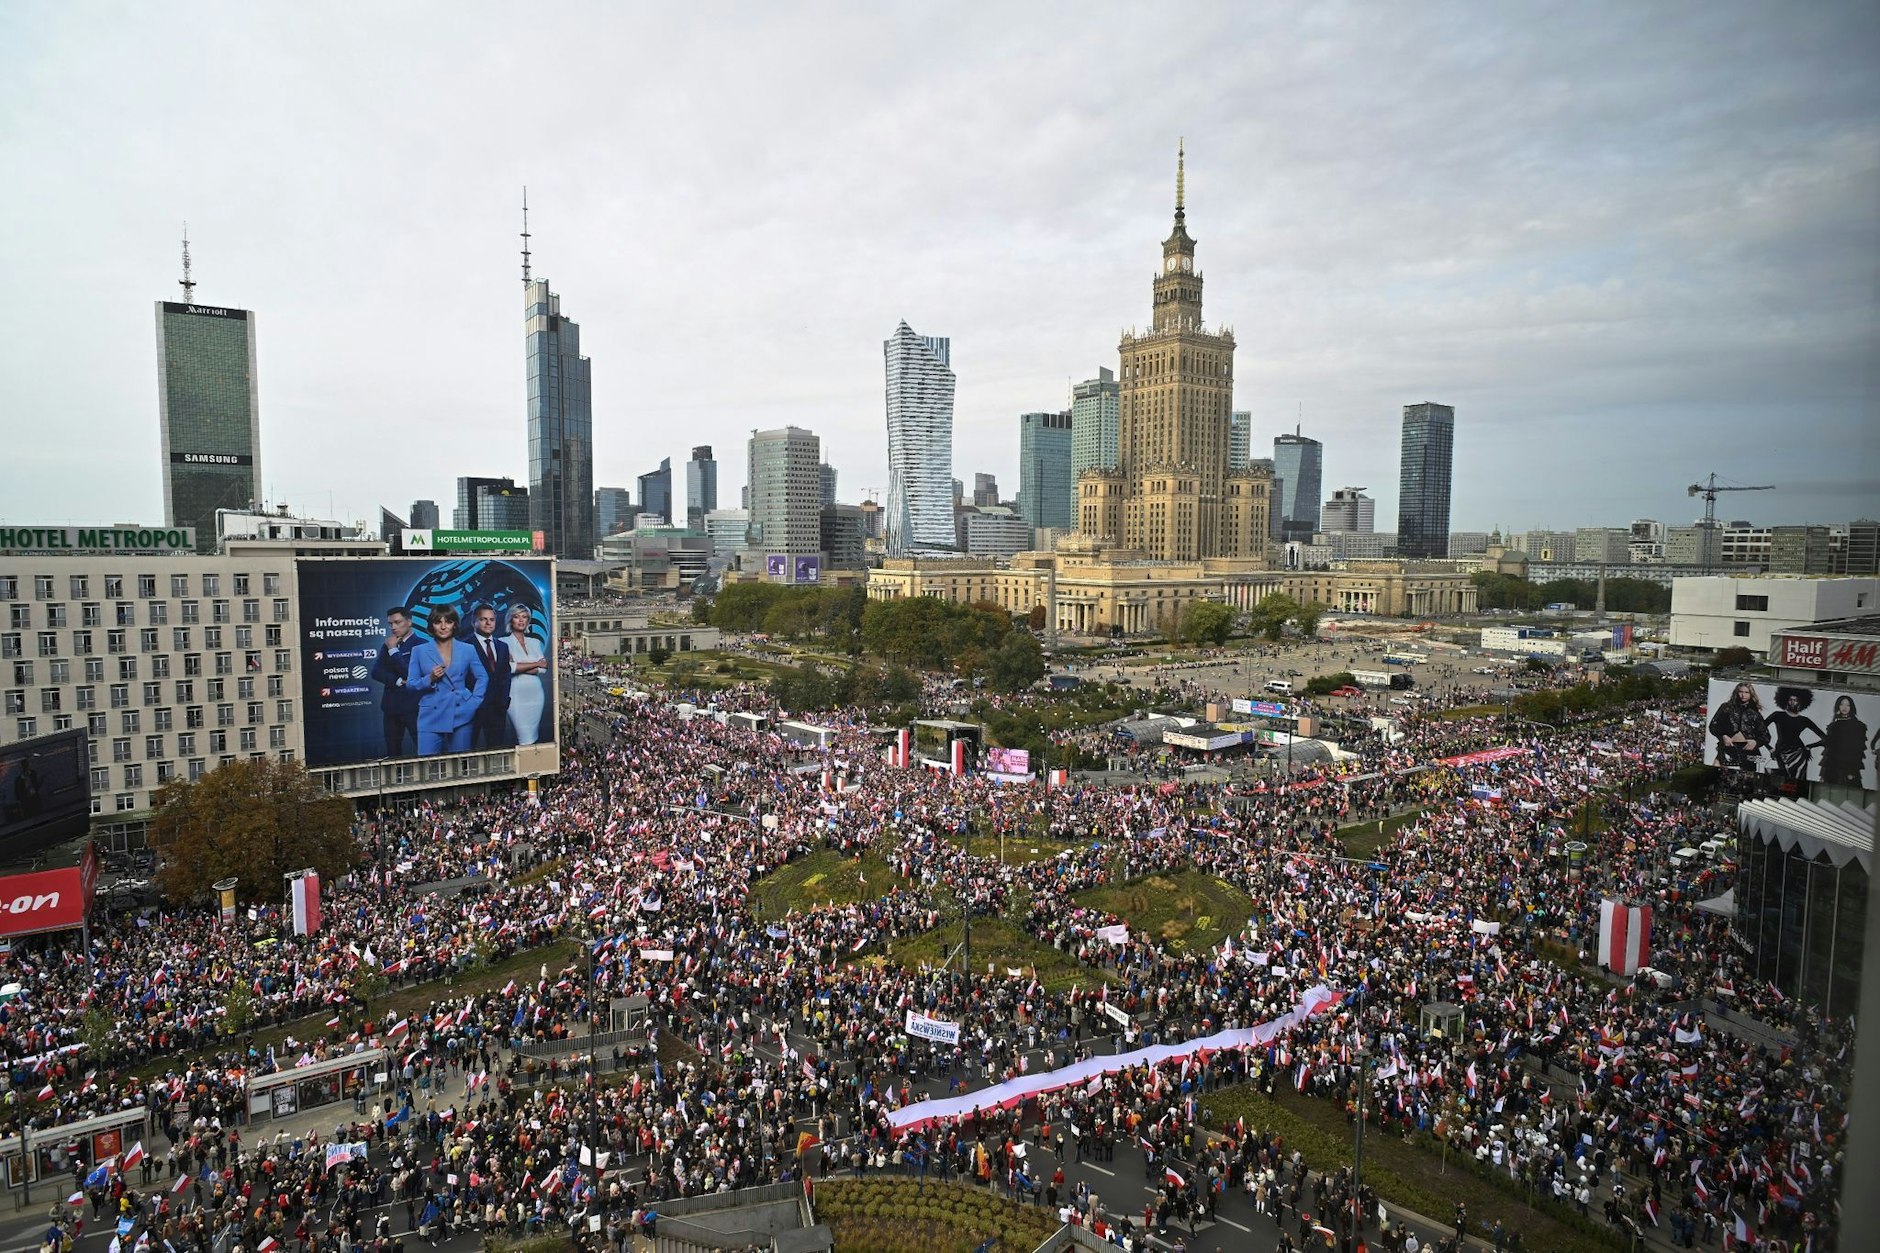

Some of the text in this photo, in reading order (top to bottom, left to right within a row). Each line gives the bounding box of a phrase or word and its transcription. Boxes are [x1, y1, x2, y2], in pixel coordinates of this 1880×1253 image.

[186, 305, 227, 316] Marriott
[184, 453, 238, 464] SAMSUNG
[0, 528, 192, 549] HOTEL METROPOL
[437, 536, 530, 544] HOTELMETROPOL.COM.PL
[315, 616, 380, 627] Informacje
[309, 626, 387, 639] są naszą siłą
[1788, 640, 1823, 655] Half
[1787, 652, 1822, 665] Price
[1833, 644, 1878, 667] H&M
[323, 667, 349, 675] polsat
